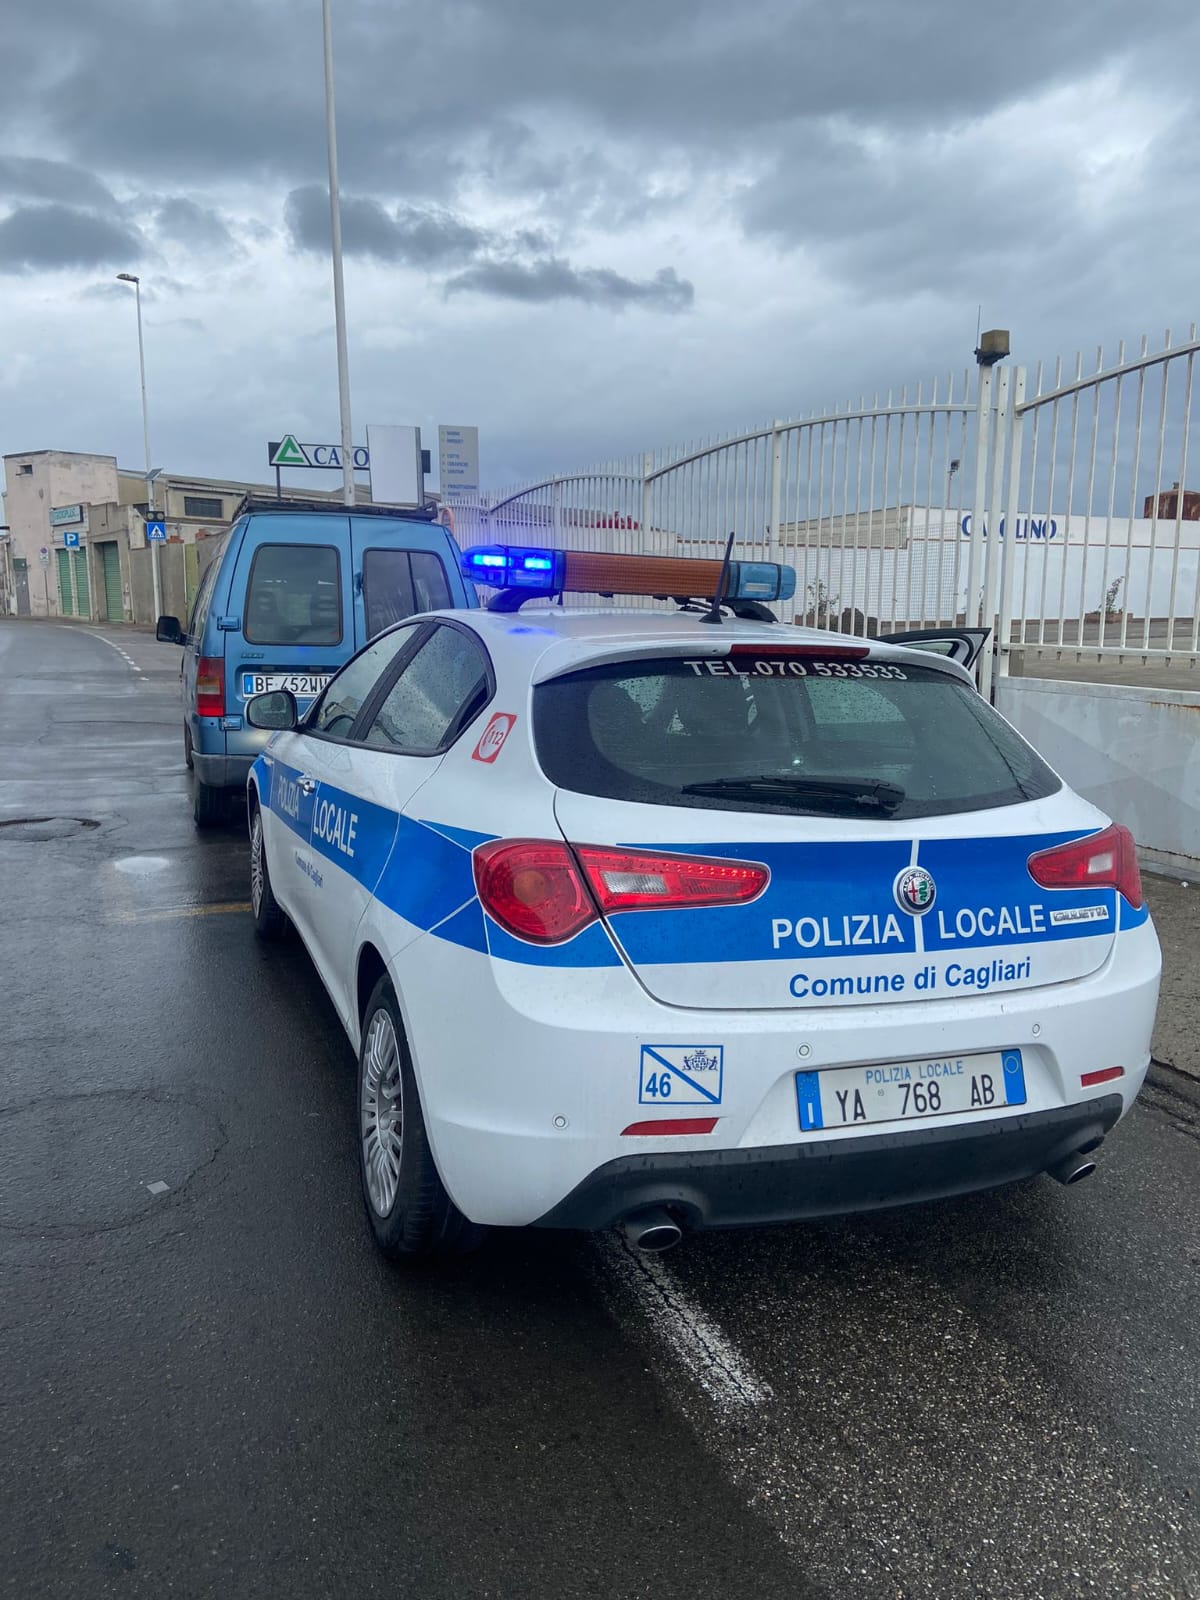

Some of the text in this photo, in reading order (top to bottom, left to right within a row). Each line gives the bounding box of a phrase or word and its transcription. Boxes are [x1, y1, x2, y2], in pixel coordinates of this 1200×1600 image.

[313, 446, 370, 467] CAO
[812, 662, 908, 681] 533533
[488, 730, 505, 745] 112
[278, 774, 359, 858] POLIZIA LOCALE
[771, 904, 1047, 949] POLIZIA LOCALE
[789, 956, 1031, 998] Comune di Cagliari
[645, 1072, 671, 1098] 46
[866, 1060, 965, 1084] POLIZIA LOCALE
[835, 1088, 867, 1122] YA
[898, 1080, 941, 1115] 768
[970, 1073, 995, 1107] AB
